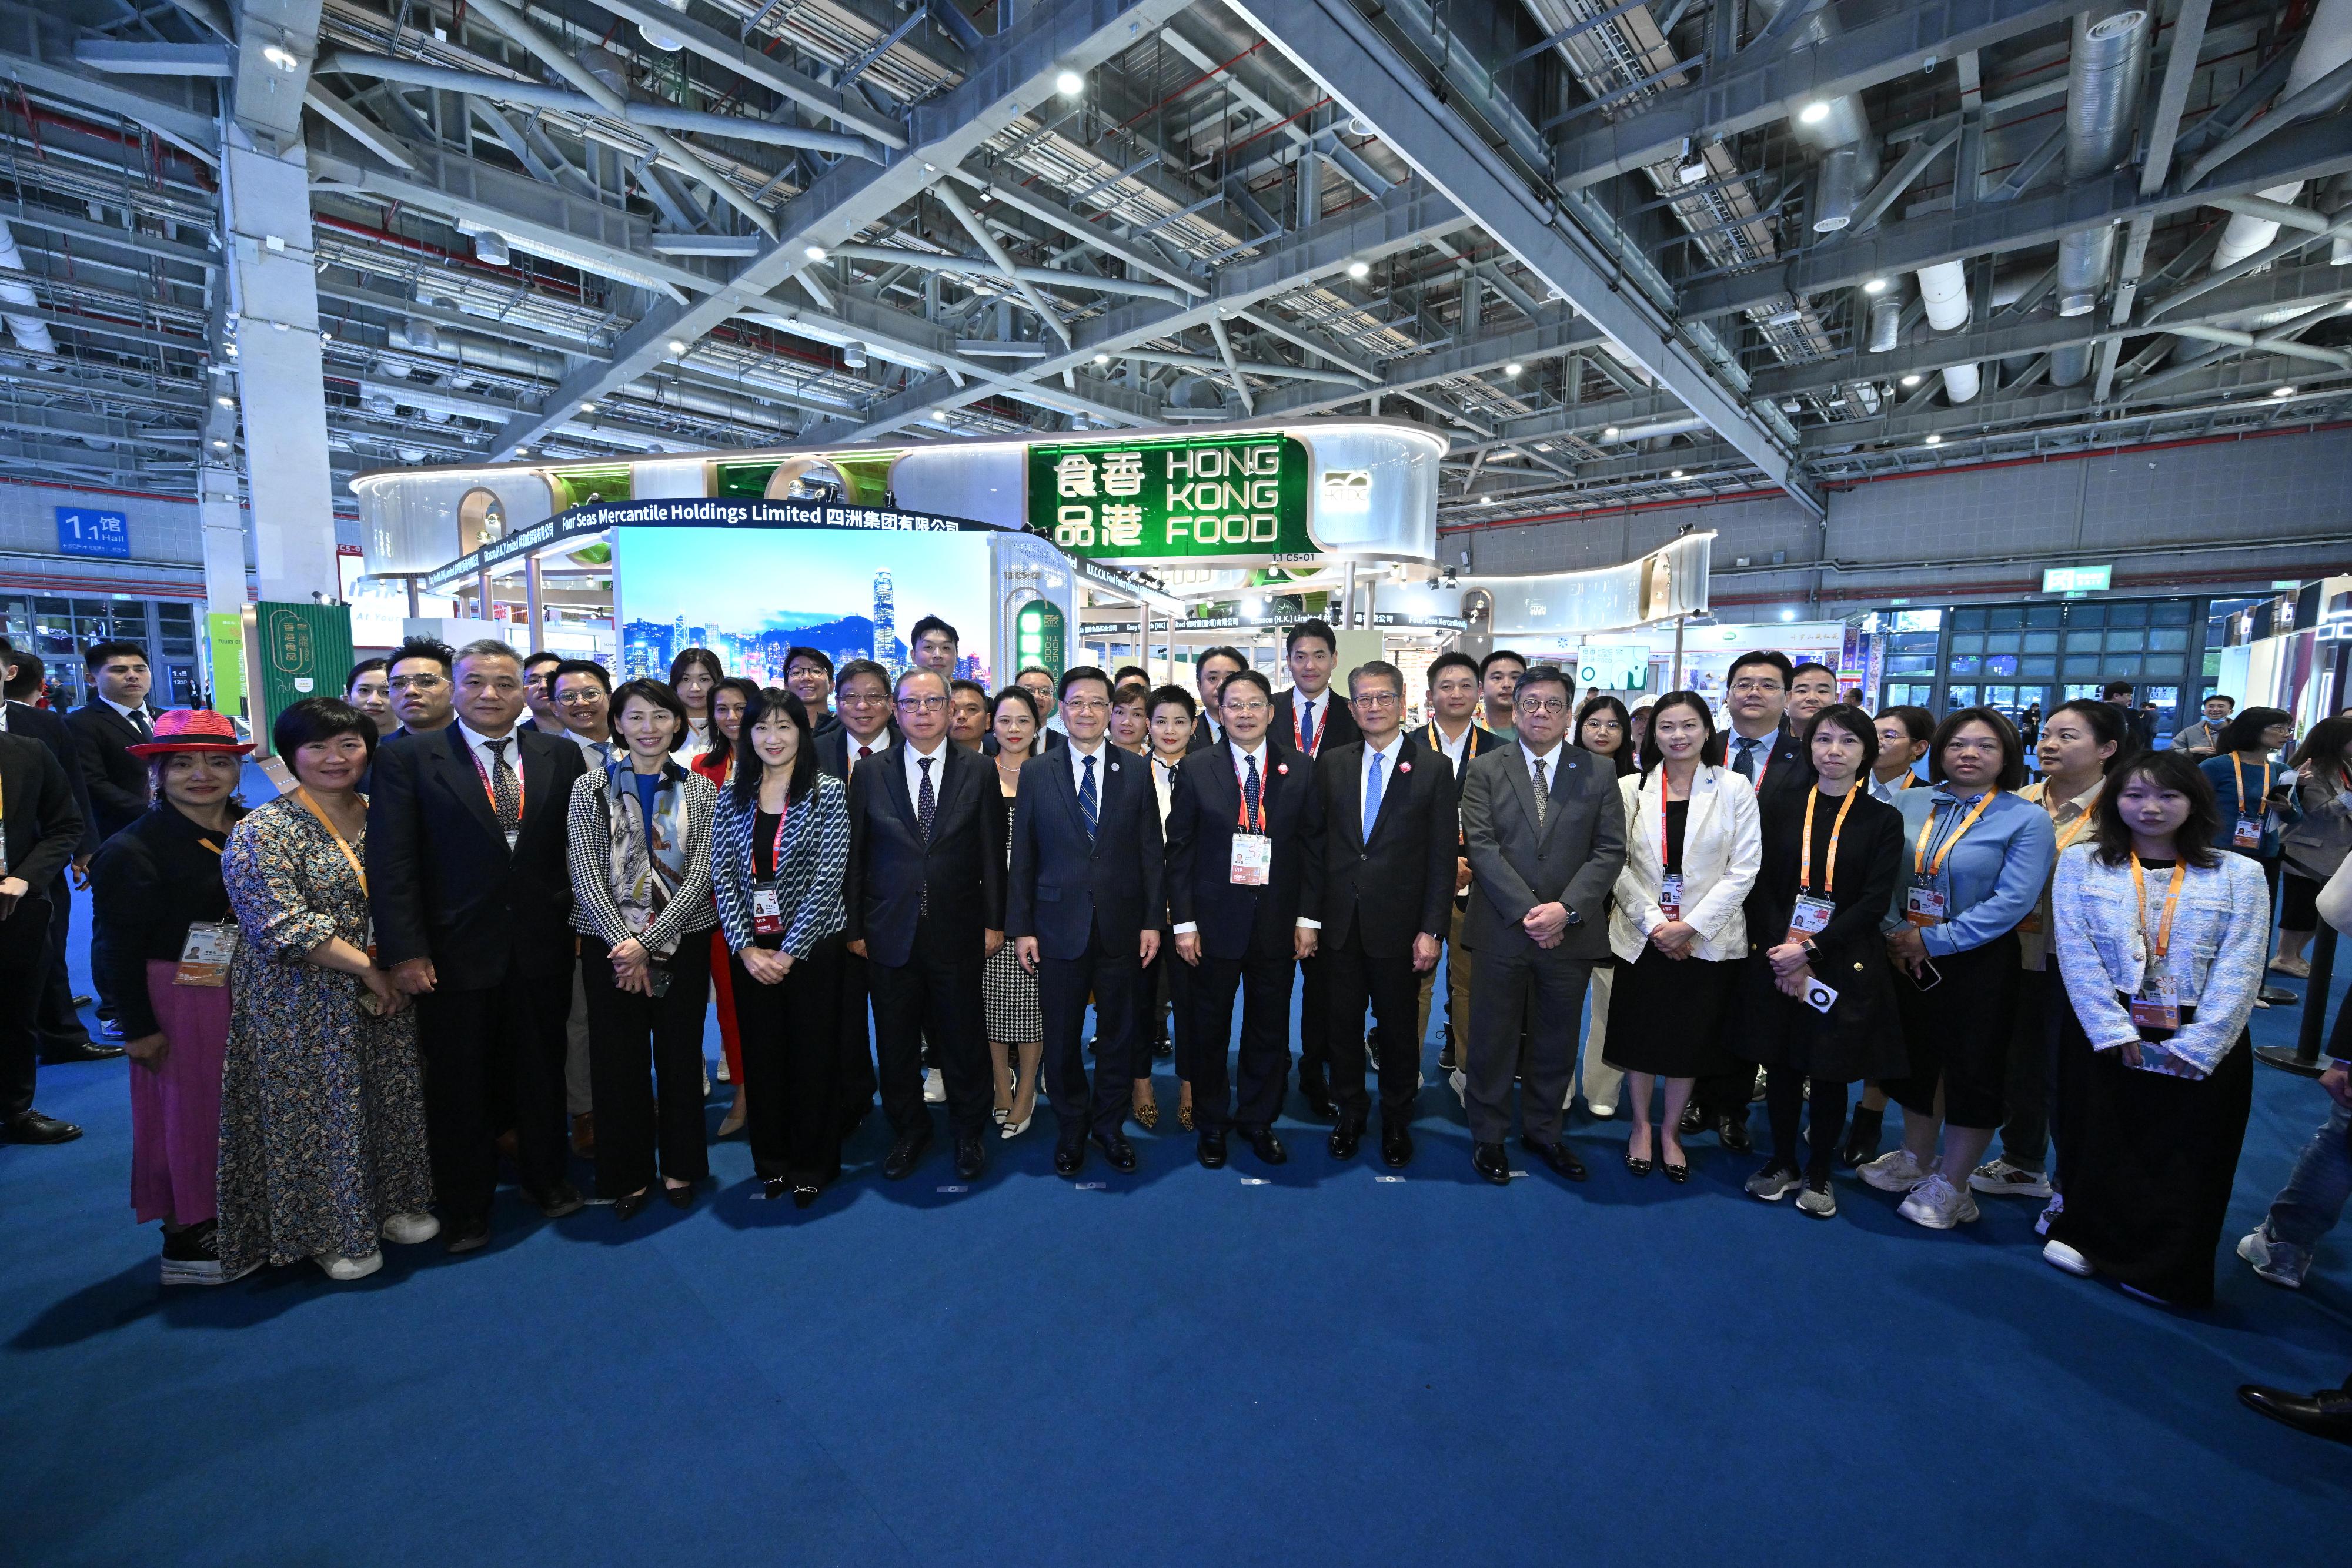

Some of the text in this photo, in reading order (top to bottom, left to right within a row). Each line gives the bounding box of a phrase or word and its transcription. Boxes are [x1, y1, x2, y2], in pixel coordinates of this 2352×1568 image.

[1167, 446, 1279, 479] HONG
[1166, 479, 1278, 511] KONG
[65, 515, 121, 540] 1.1 馆
[562, 503, 960, 531] Four Seas Mercantile Holdings Limited 四洲集团有限公司
[102, 534, 124, 542] Hall
[1166, 514, 1278, 544] FOOD
[506, 537, 519, 554] Limited
[1107, 572, 1116, 586] Food
[1115, 574, 1128, 591] Factory
[1155, 622, 1165, 630] (HK)
[1167, 621, 1185, 629] Lited
[1274, 615, 1292, 624] (H.K.)
[1295, 614, 1322, 623] Limid
[1439, 618, 1459, 627] Mercantile
[473, 753, 485, 778] SHANGHAI
